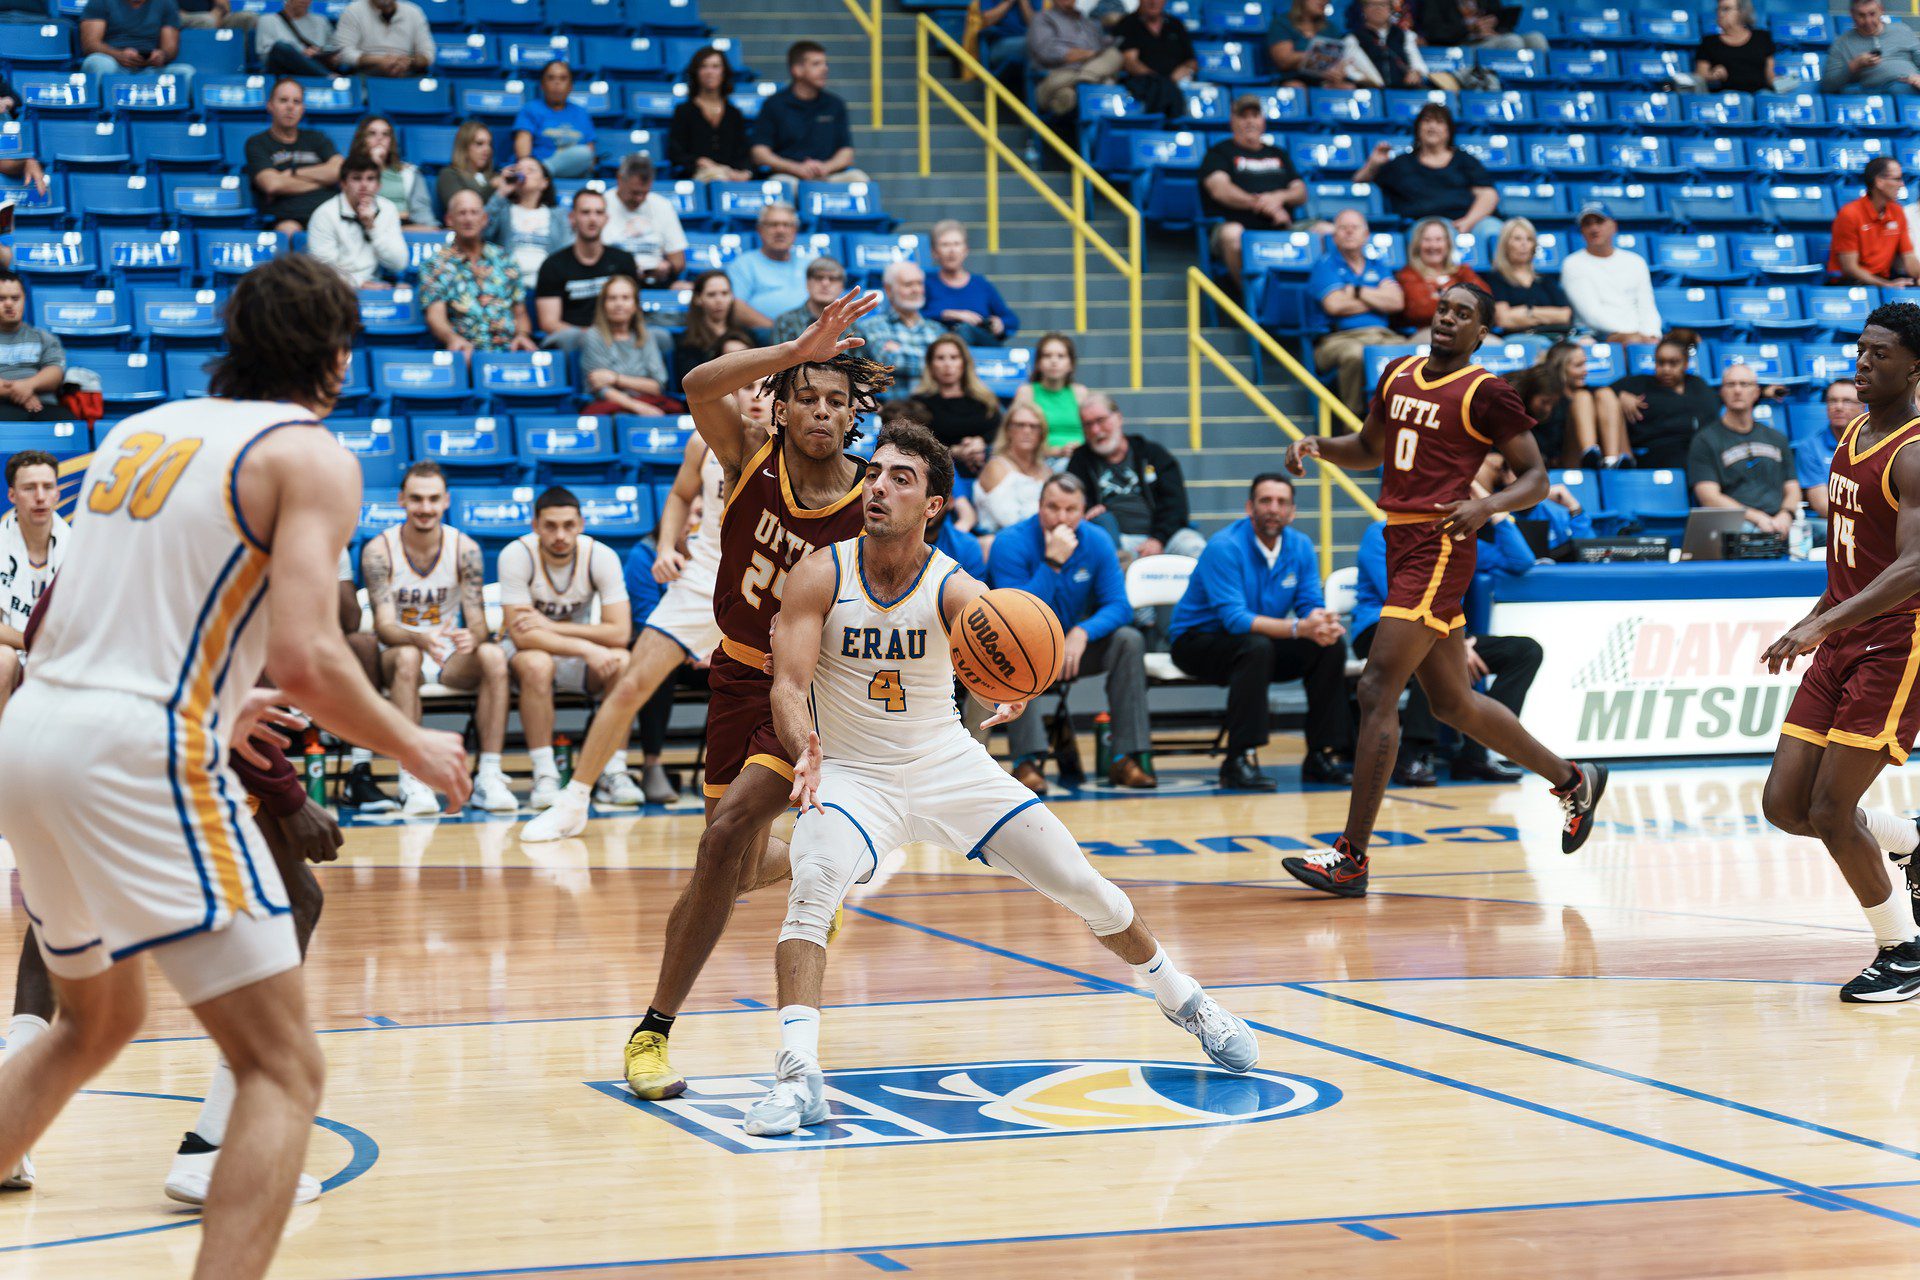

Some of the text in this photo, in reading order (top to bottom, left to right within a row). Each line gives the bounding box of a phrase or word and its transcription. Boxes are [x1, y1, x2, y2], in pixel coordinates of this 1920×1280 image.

[1390, 393, 1441, 430] UFTL
[1394, 427, 1420, 472] 0
[87, 431, 203, 521] 30
[1829, 471, 1864, 514] UFTL
[1833, 511, 1857, 569] 14
[398, 587, 448, 604] ERAU
[841, 626, 928, 660] ERAU
[967, 606, 1016, 679] Wilson
[952, 647, 982, 685] EVO
[867, 669, 907, 713] 4
[1577, 685, 1800, 742] MITSU
